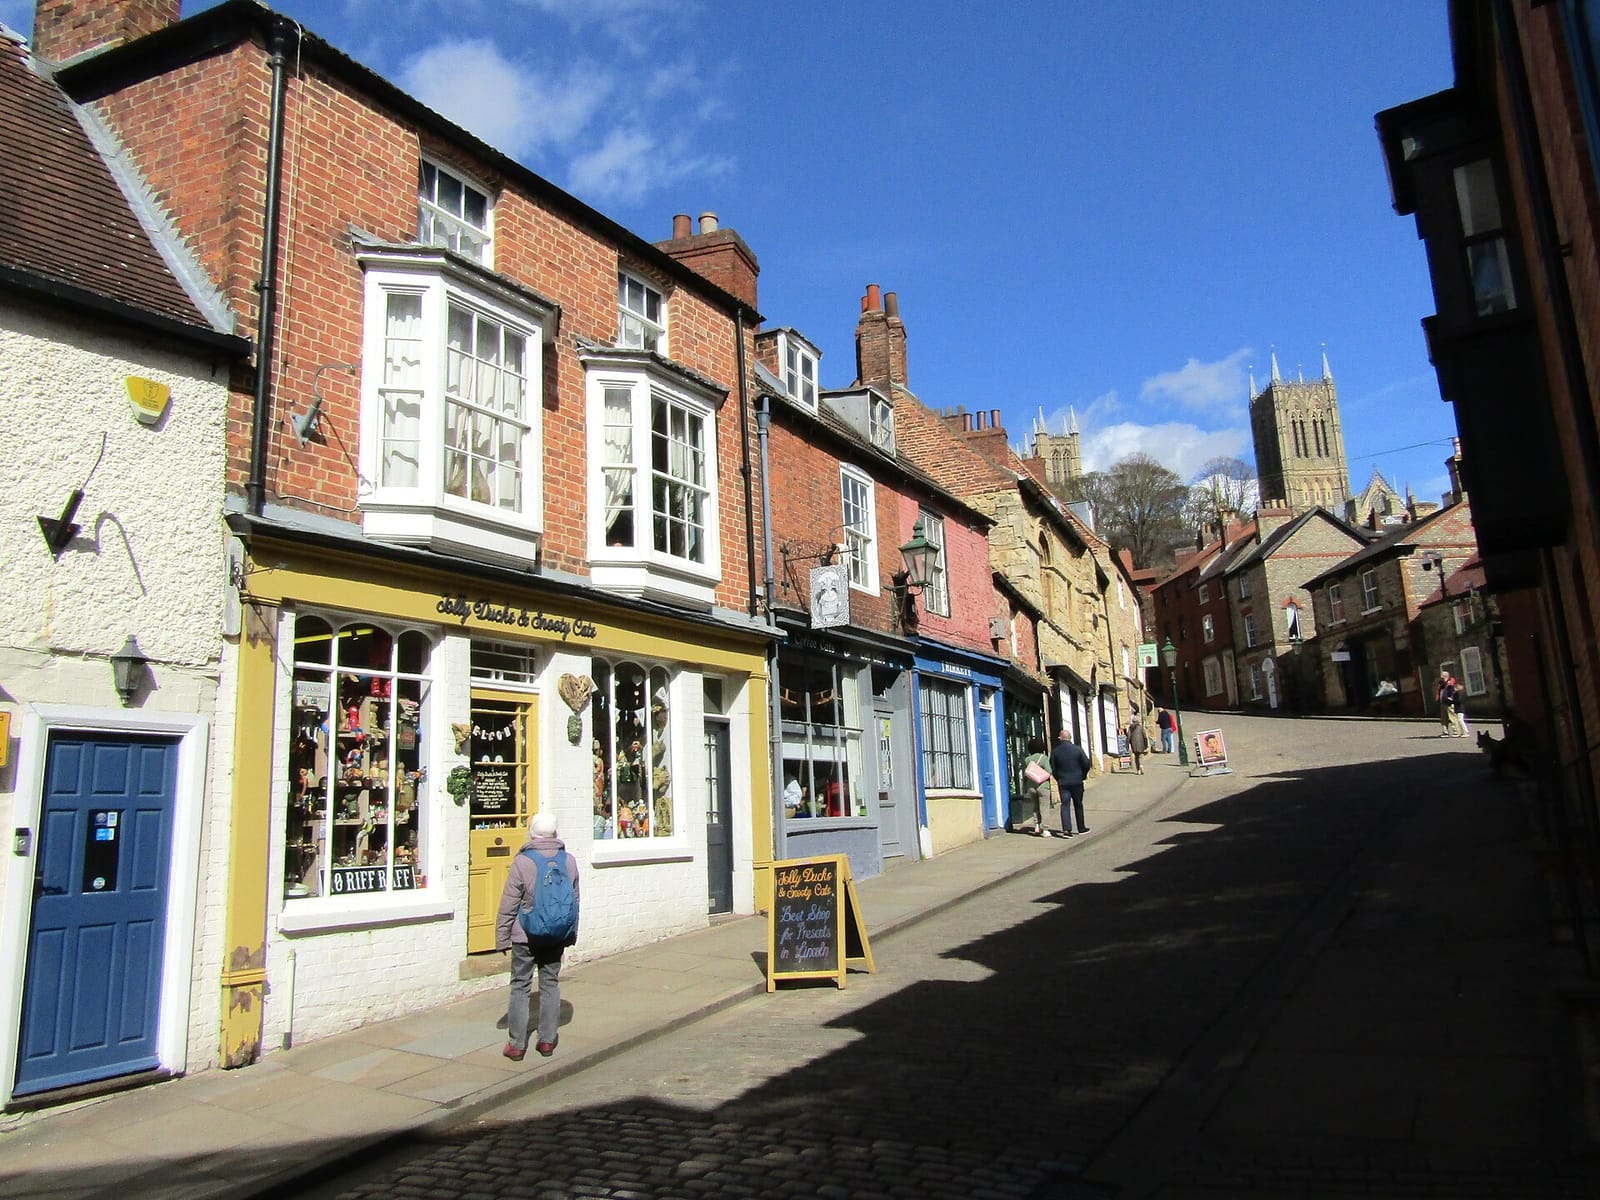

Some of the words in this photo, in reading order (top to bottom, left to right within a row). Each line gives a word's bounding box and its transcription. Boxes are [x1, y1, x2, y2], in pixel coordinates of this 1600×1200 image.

[436, 593, 471, 625] Jolly
[472, 598, 516, 625] Ducks
[517, 606, 529, 627] &
[531, 608, 571, 641] Snooty
[573, 617, 597, 639] Cats
[345, 871, 376, 891] RIFF
[378, 869, 410, 888] RFF
[778, 868, 801, 886] Jolly
[802, 867, 832, 882] Ducks
[778, 888, 785, 898] &
[787, 885, 812, 901] Snooty
[814, 883, 831, 896] Cats
[780, 905, 804, 922] Best
[806, 904, 831, 924] Shop
[780, 927, 794, 945] for
[796, 921, 831, 940] Presents
[781, 947, 789, 959] in
[795, 941, 830, 963] Lincoln
